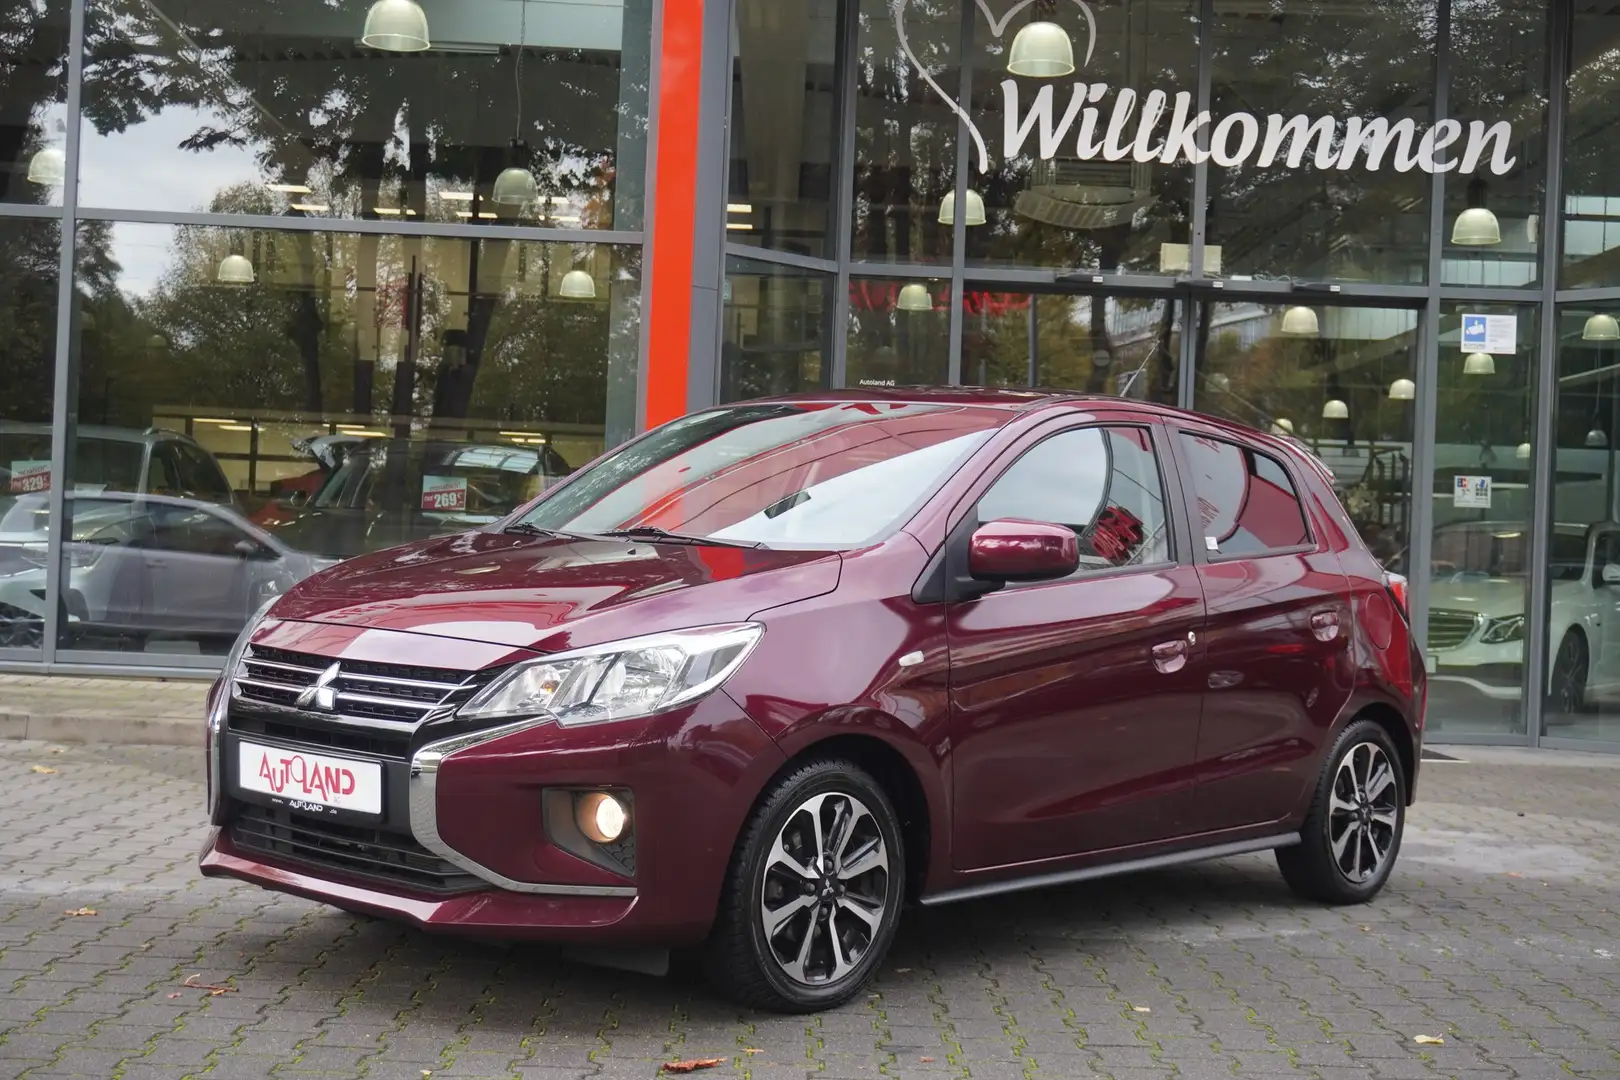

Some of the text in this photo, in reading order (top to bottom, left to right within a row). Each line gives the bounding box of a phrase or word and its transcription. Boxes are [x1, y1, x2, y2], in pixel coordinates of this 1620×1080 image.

[1000, 79, 1516, 175] Willkommen
[22, 475, 44, 491] 329
[434, 492, 457, 508] 269
[259, 752, 355, 801] AUTOLAND
[289, 799, 324, 812] AUTOLAND
